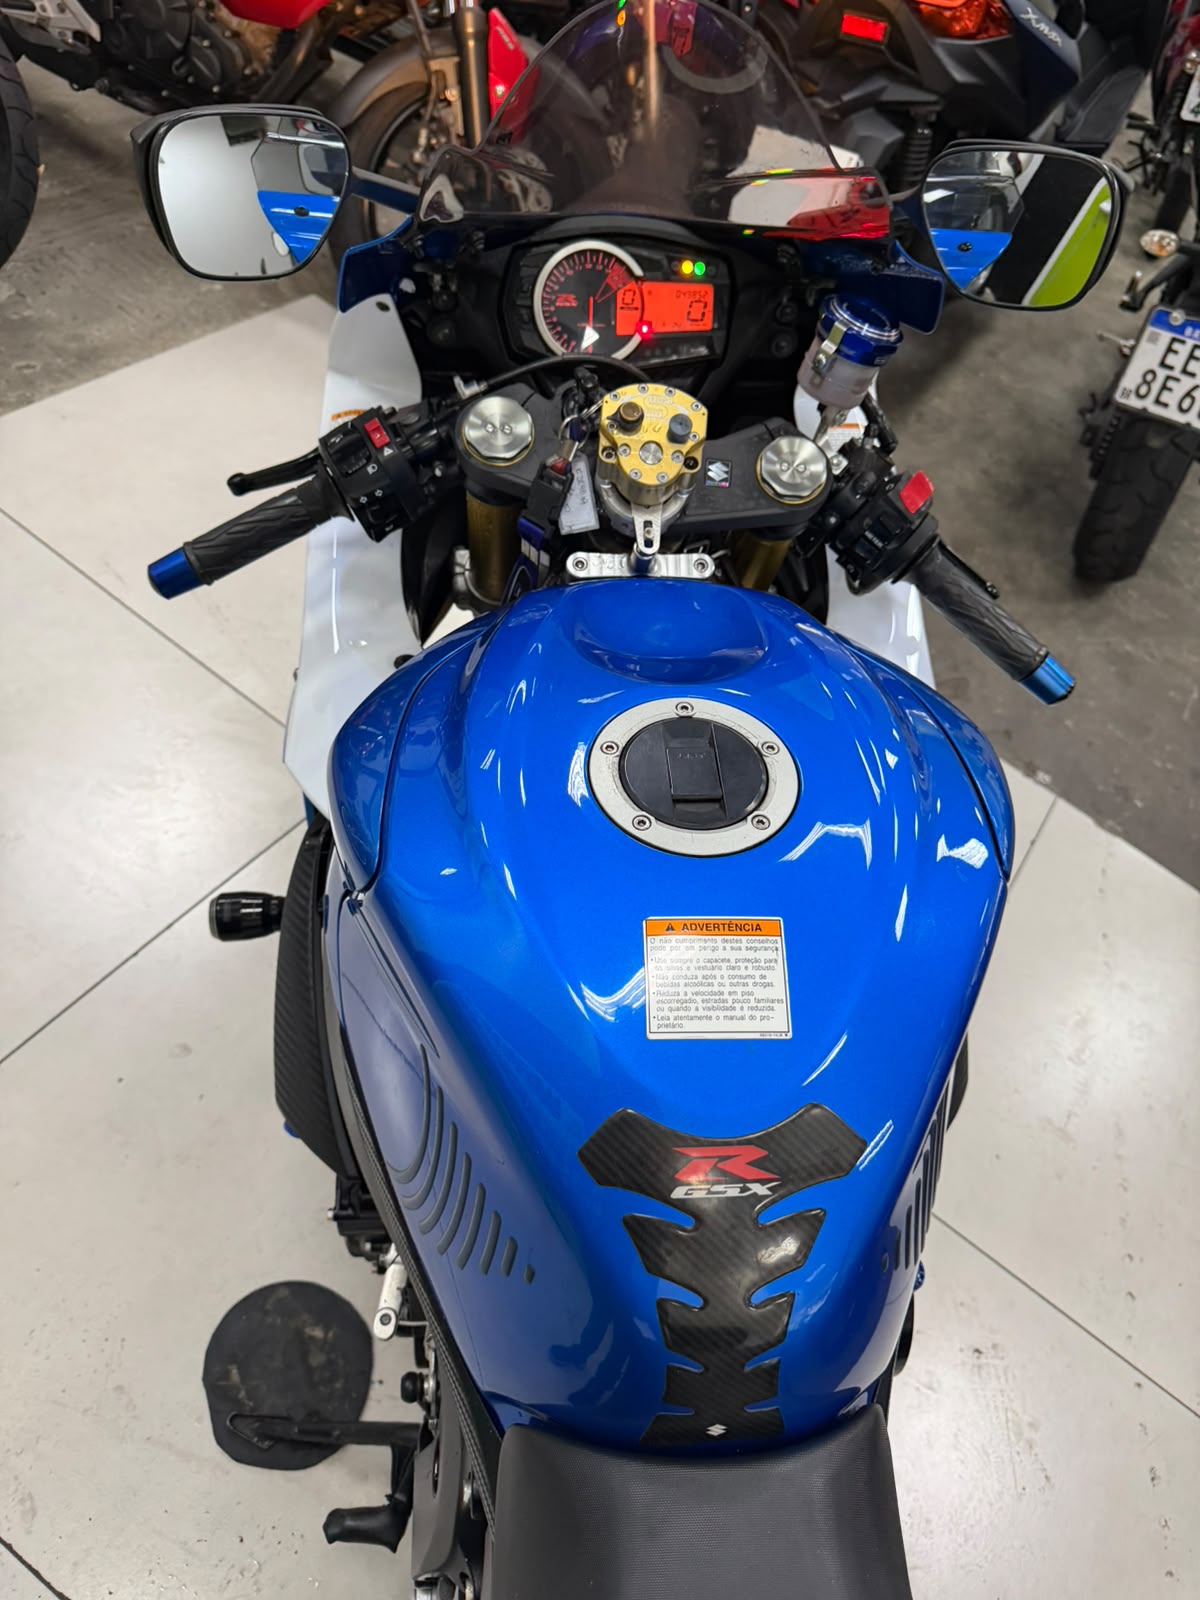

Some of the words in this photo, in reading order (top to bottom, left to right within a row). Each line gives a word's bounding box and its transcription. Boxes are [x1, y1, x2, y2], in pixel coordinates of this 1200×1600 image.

[1134, 369, 1200, 418] 8E6
[681, 920, 763, 932] ADVERTÊNCIA
[720, 937, 743, 945] destes
[745, 937, 779, 945] conselhos
[649, 945, 667, 953] pode
[698, 945, 720, 953] perigo
[745, 945, 779, 953] segurança
[734, 957, 762, 965] proteção
[763, 957, 778, 965] para
[694, 964, 723, 972] vestuário
[726, 964, 741, 972] claro
[701, 973, 717, 981] após
[701, 997, 729, 1005] estradas
[731, 997, 752, 1005] pouco
[753, 997, 785, 1005] familiares
[667, 1005, 692, 1013] quando
[702, 1004, 737, 1012] visibilidade
[672, 1145, 781, 1182] R
[670, 1181, 782, 1200] GSX
